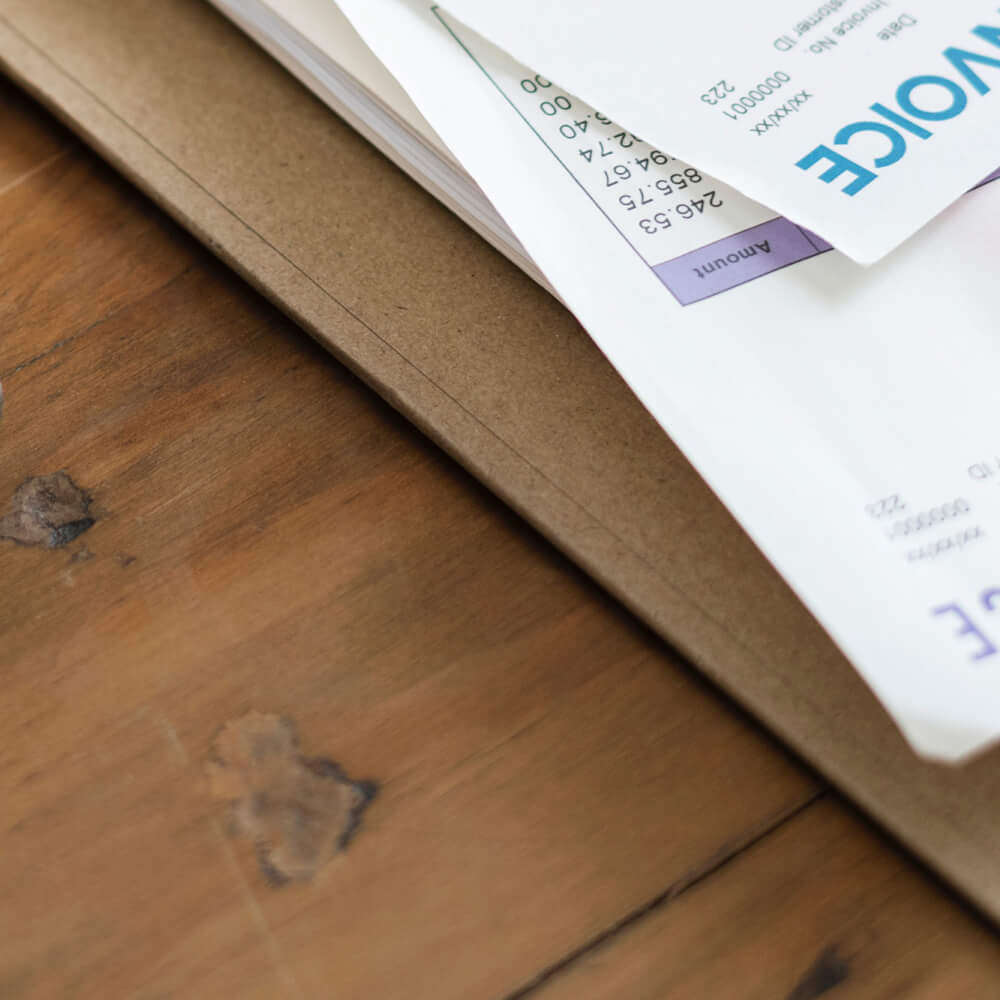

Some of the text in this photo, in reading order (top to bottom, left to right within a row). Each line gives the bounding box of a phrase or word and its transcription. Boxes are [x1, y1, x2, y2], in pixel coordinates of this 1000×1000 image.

[773, 35, 797, 53] ID
[877, 13, 917, 41] Date
[700, 79, 735, 106] 223
[723, 70, 790, 121] 0000001
[750, 89, 813, 136] xx/xx/xx
[794, 7, 1000, 197] VOICE
[578, 131, 643, 163] 2.74
[603, 150, 676, 188] 94.67
[618, 167, 703, 211] 855.75
[639, 190, 724, 235] 246.53
[692, 239, 772, 279] Amount
